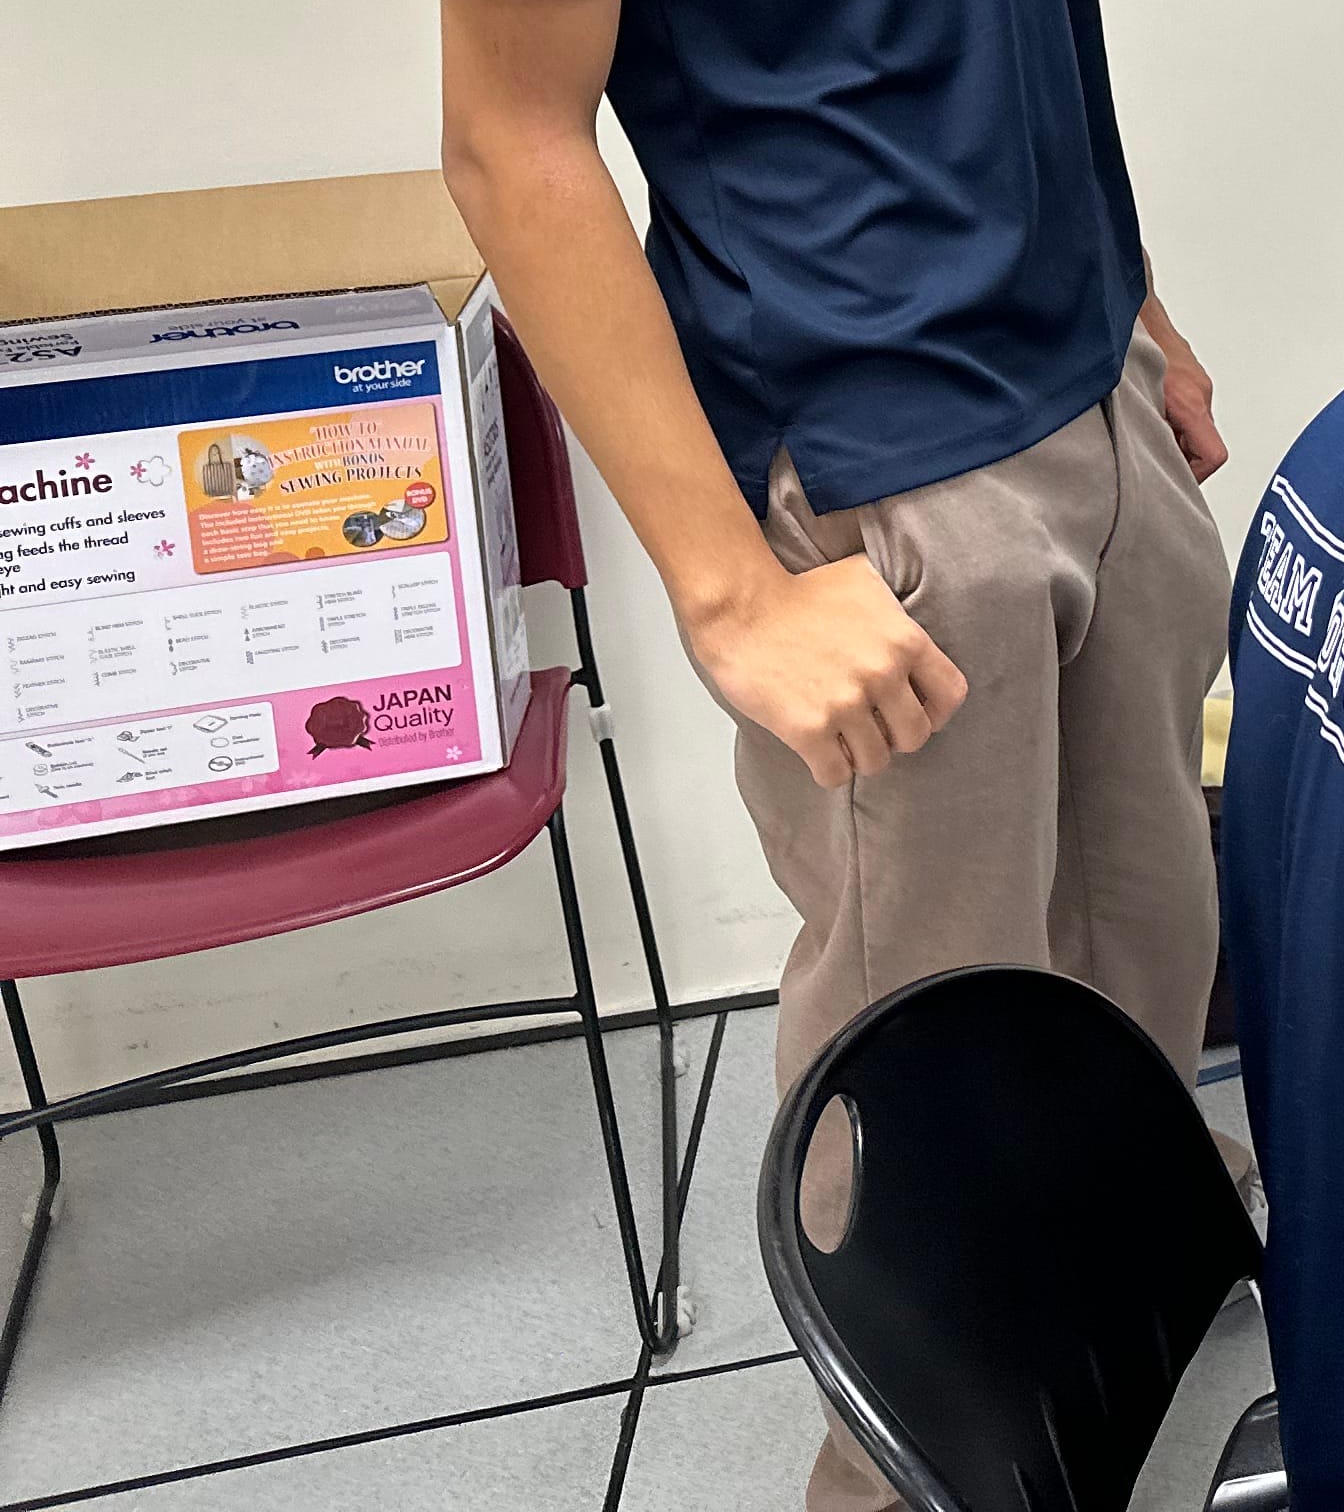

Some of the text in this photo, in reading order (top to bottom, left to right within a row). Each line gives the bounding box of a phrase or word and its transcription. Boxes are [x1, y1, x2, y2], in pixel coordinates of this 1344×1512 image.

[150, 320, 299, 343] brother
[333, 359, 426, 384] brother
[351, 377, 412, 394] at your side
[267, 436, 429, 469] INSTRUCTION MANUAL
[342, 452, 385, 467] BONUS
[0, 470, 113, 505] achine
[280, 465, 422, 494] SEWING PROJECTS
[50, 516, 82, 532] cuffs
[86, 512, 113, 527] and
[117, 508, 166, 523] sleeves
[17, 541, 55, 558] feeds
[58, 538, 80, 553] the
[84, 531, 129, 549] thread
[18, 578, 46, 595] and
[50, 575, 83, 591] easy
[86, 569, 136, 584] sewing
[1257, 510, 1323, 637] TEAM
[372, 684, 452, 712] JAPAN
[374, 707, 454, 732] Quality
[429, 727, 454, 740] Brother
